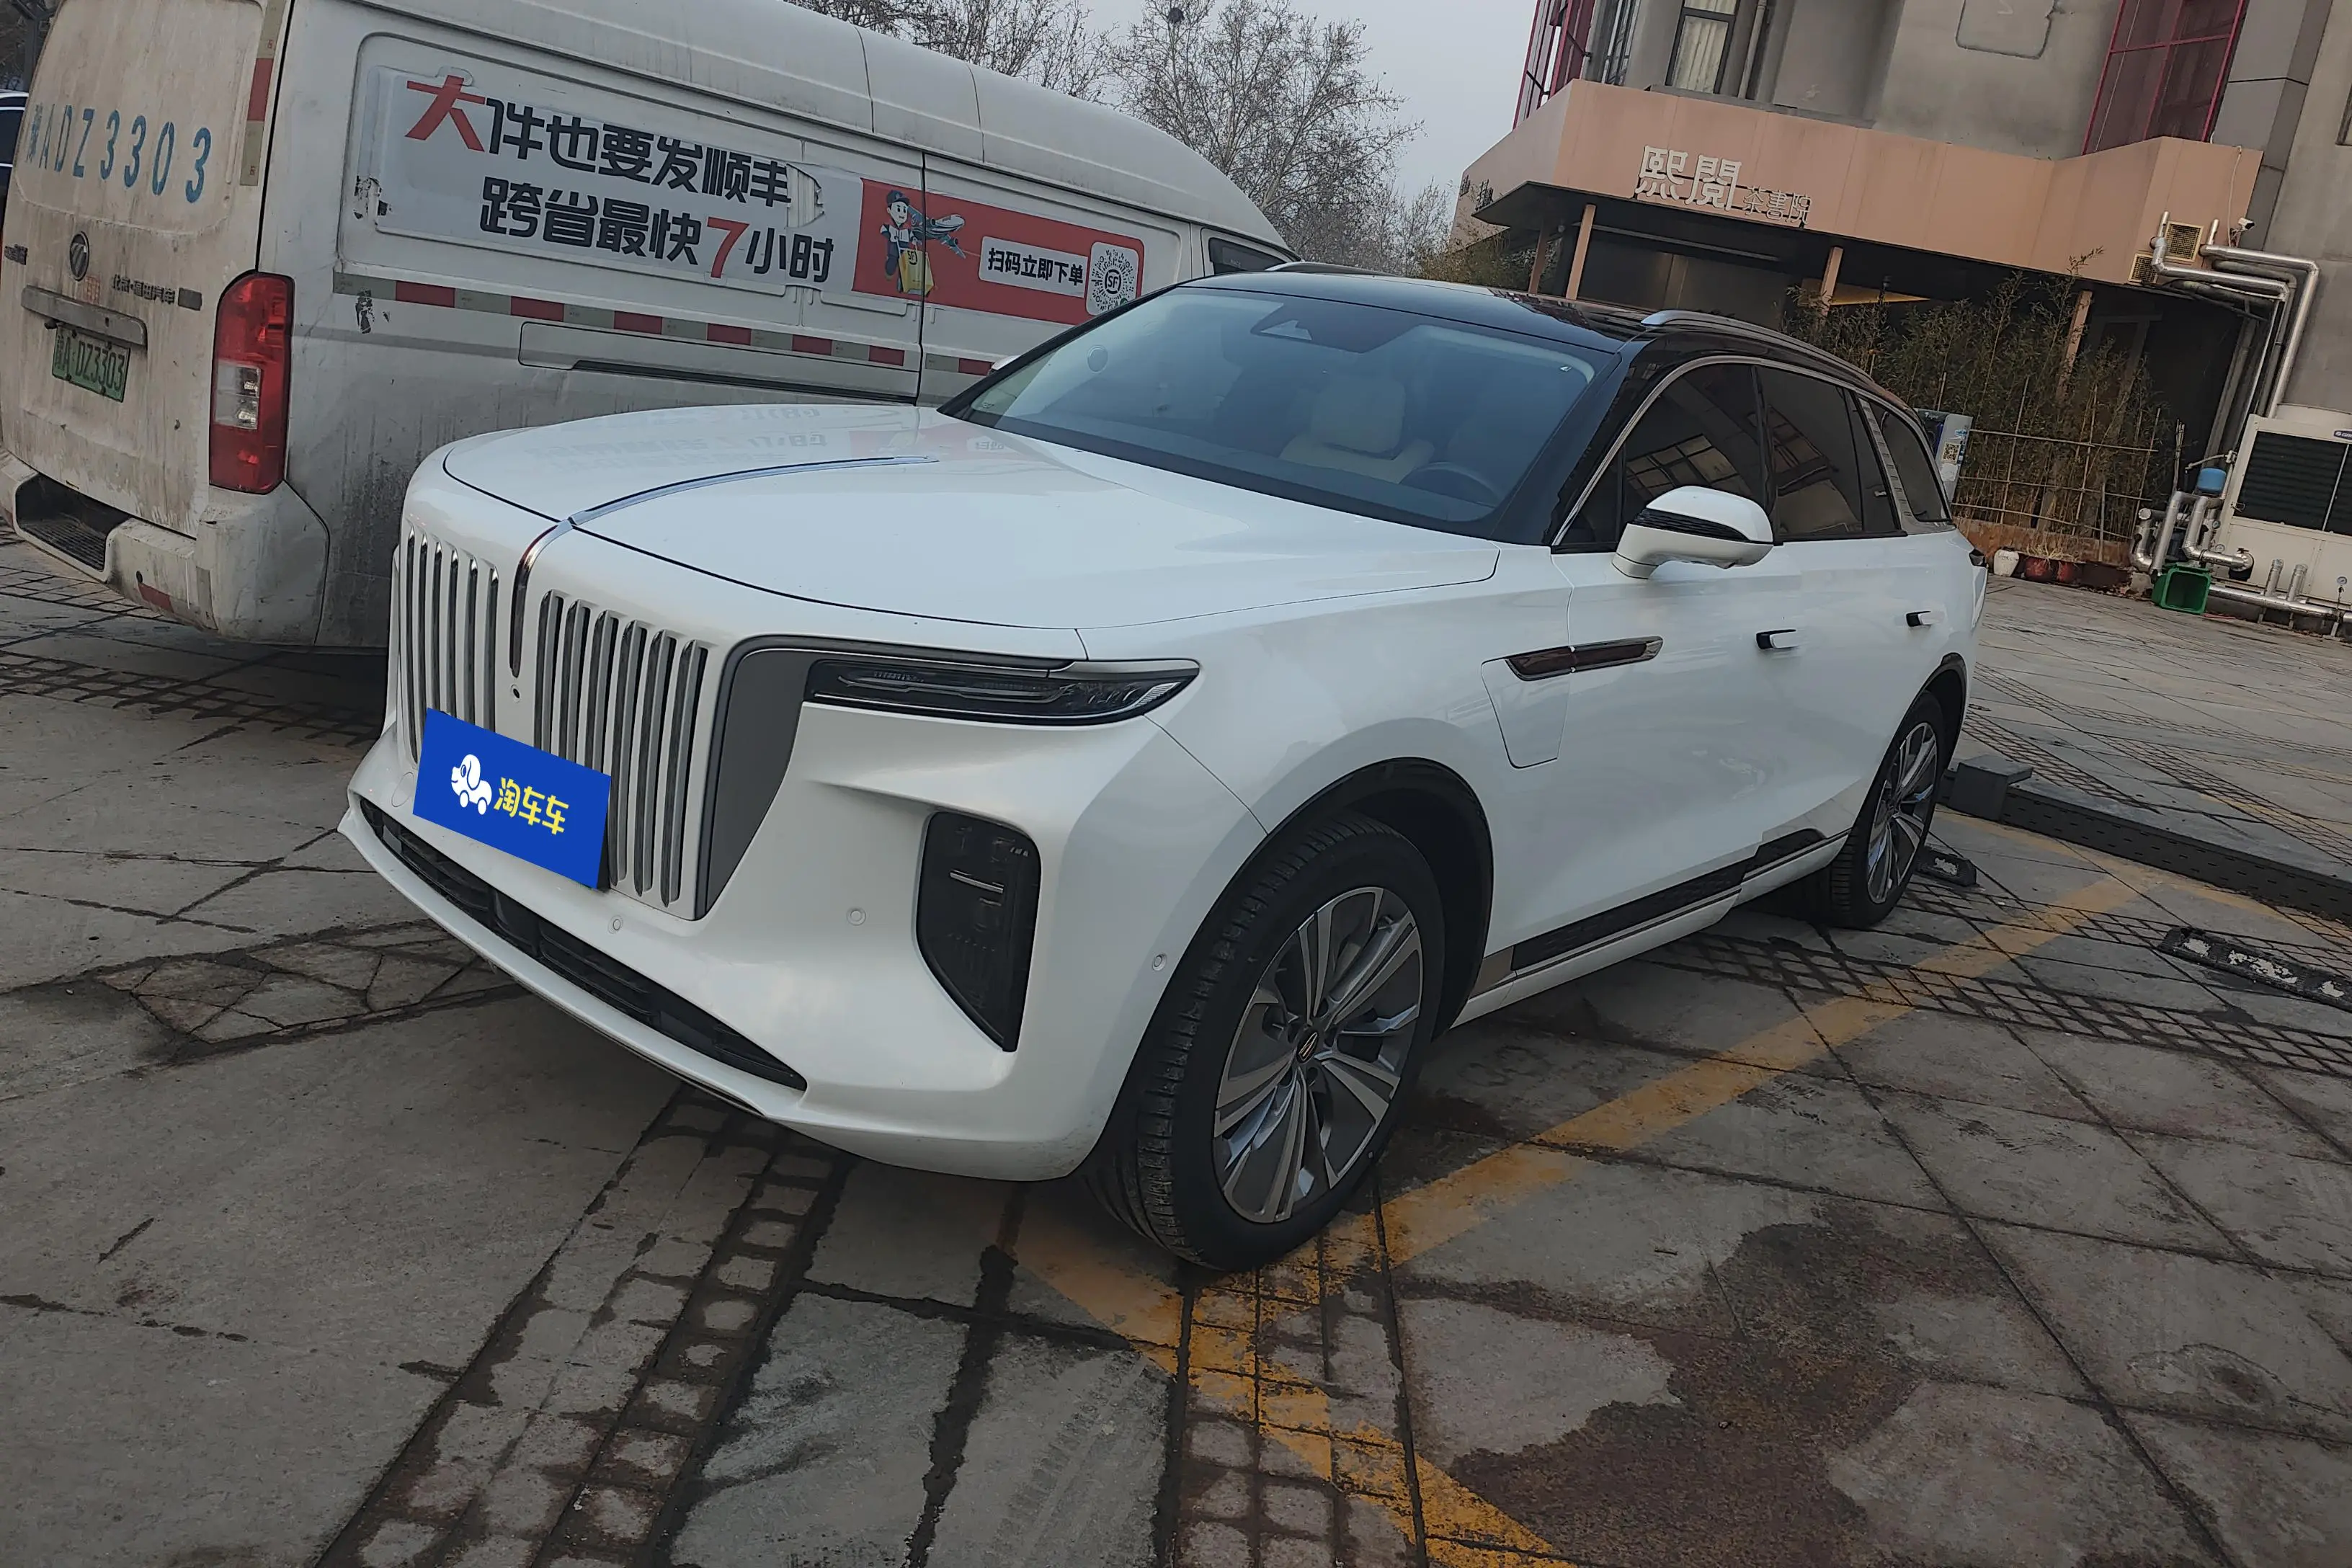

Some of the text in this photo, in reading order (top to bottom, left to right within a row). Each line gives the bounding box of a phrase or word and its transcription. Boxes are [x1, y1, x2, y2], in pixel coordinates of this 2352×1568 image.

[404, 74, 791, 207] 大件也要发顺丰
[479, 176, 834, 283] 跨省最快7小时
[987, 246, 1084, 285] 扫码立即下单
